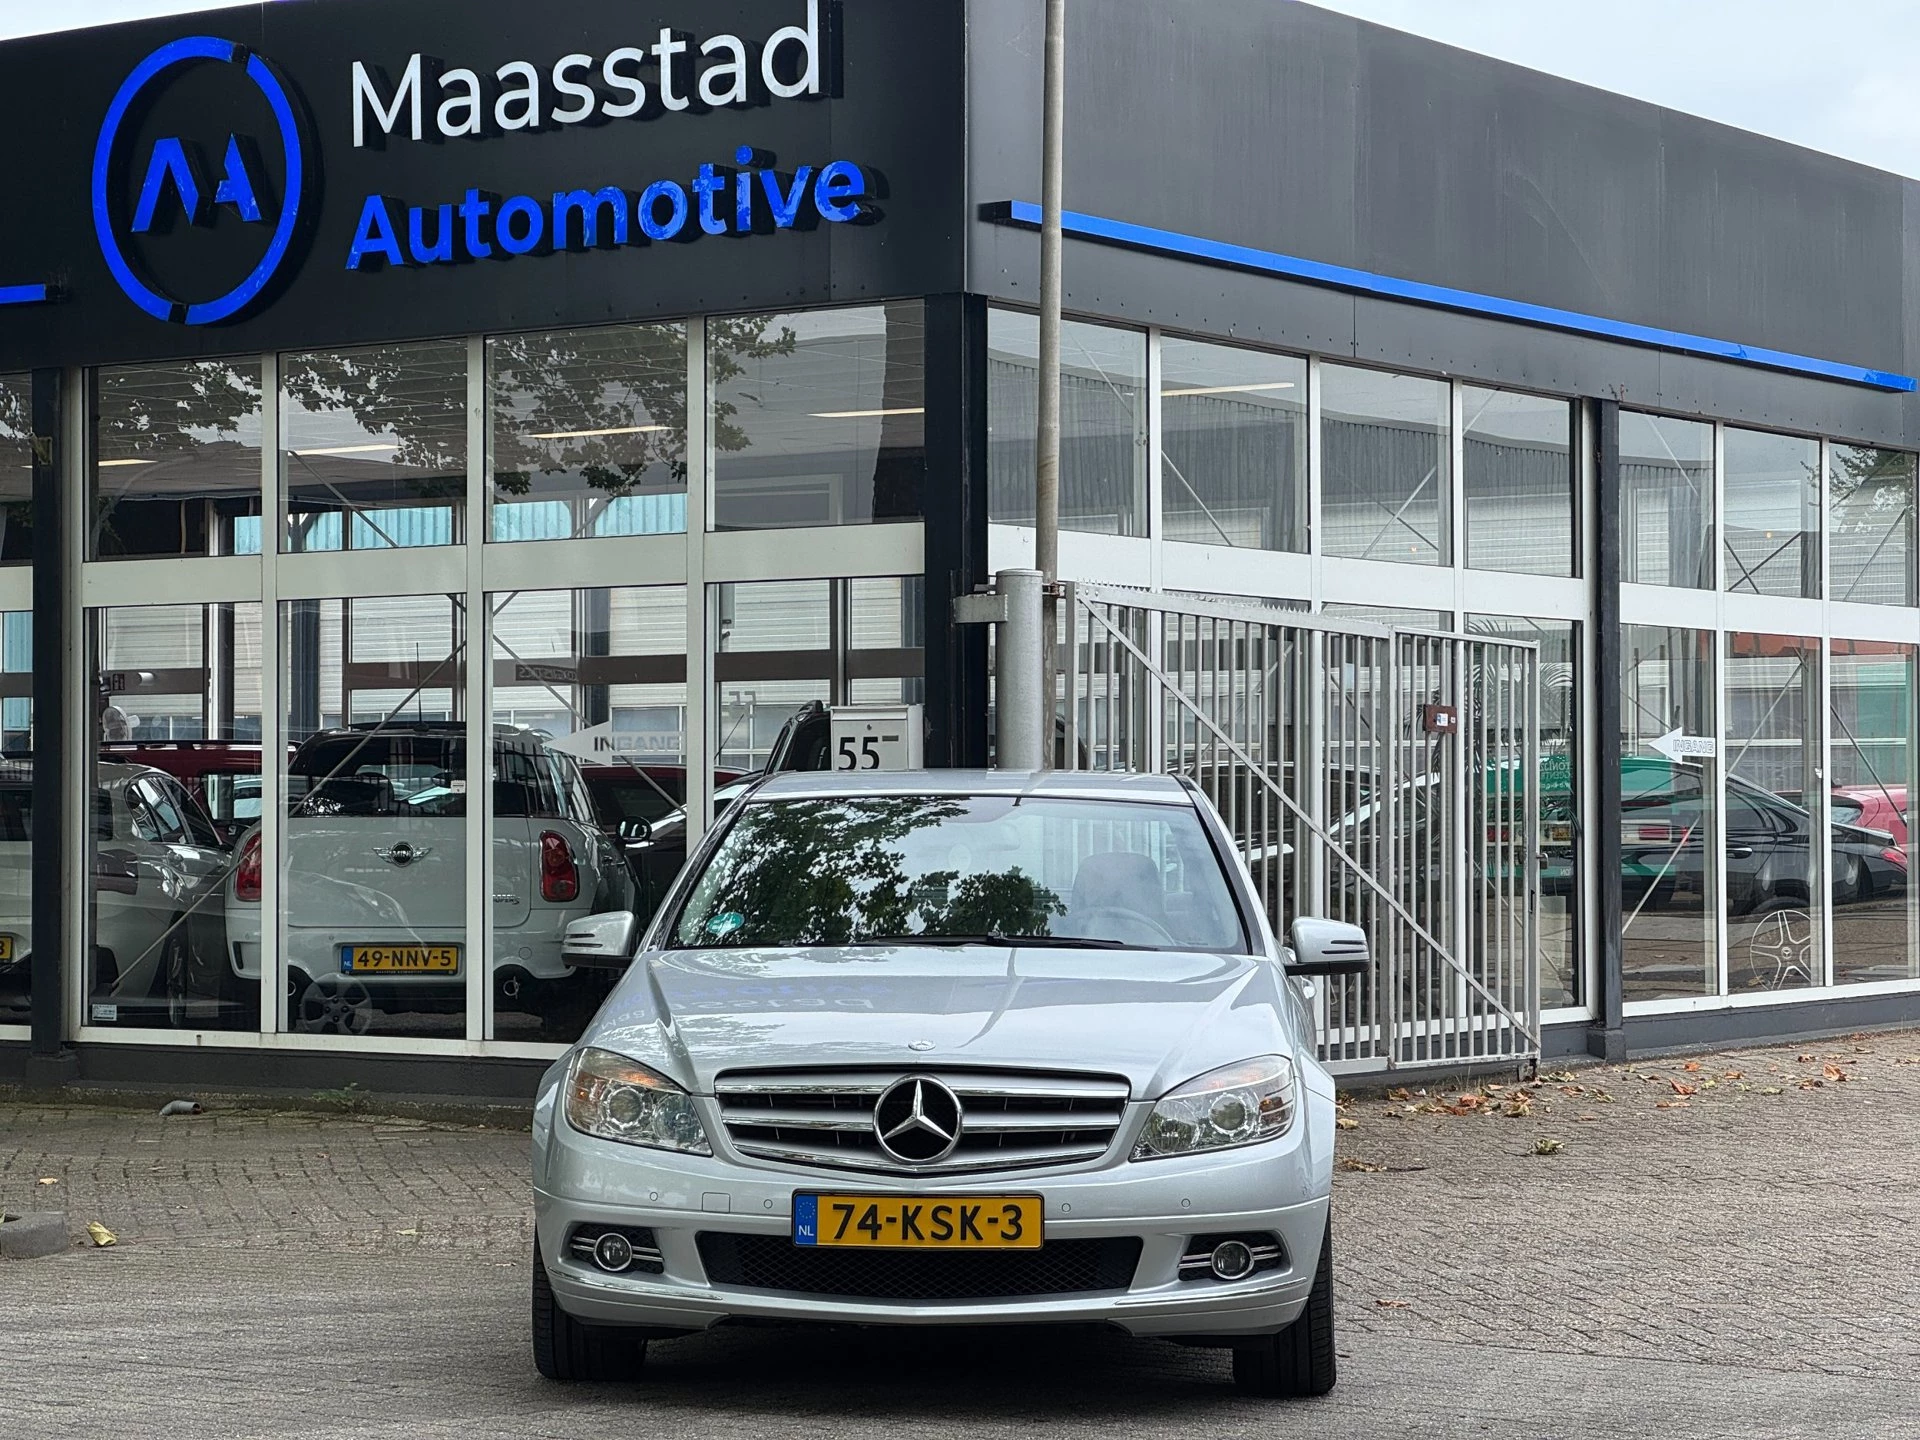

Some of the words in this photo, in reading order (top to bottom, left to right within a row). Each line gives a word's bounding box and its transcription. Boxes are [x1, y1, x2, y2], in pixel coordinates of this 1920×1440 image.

[352, 0, 820, 148] Maasstad
[345, 145, 867, 271] Automotive
[594, 735, 680, 752] INGANG
[838, 736, 880, 769] 55
[1672, 739, 1714, 754] INGANG
[357, 950, 451, 967] 49-NNV-5
[798, 1225, 815, 1237] NL
[832, 1203, 1023, 1241] 74-KSK-3
